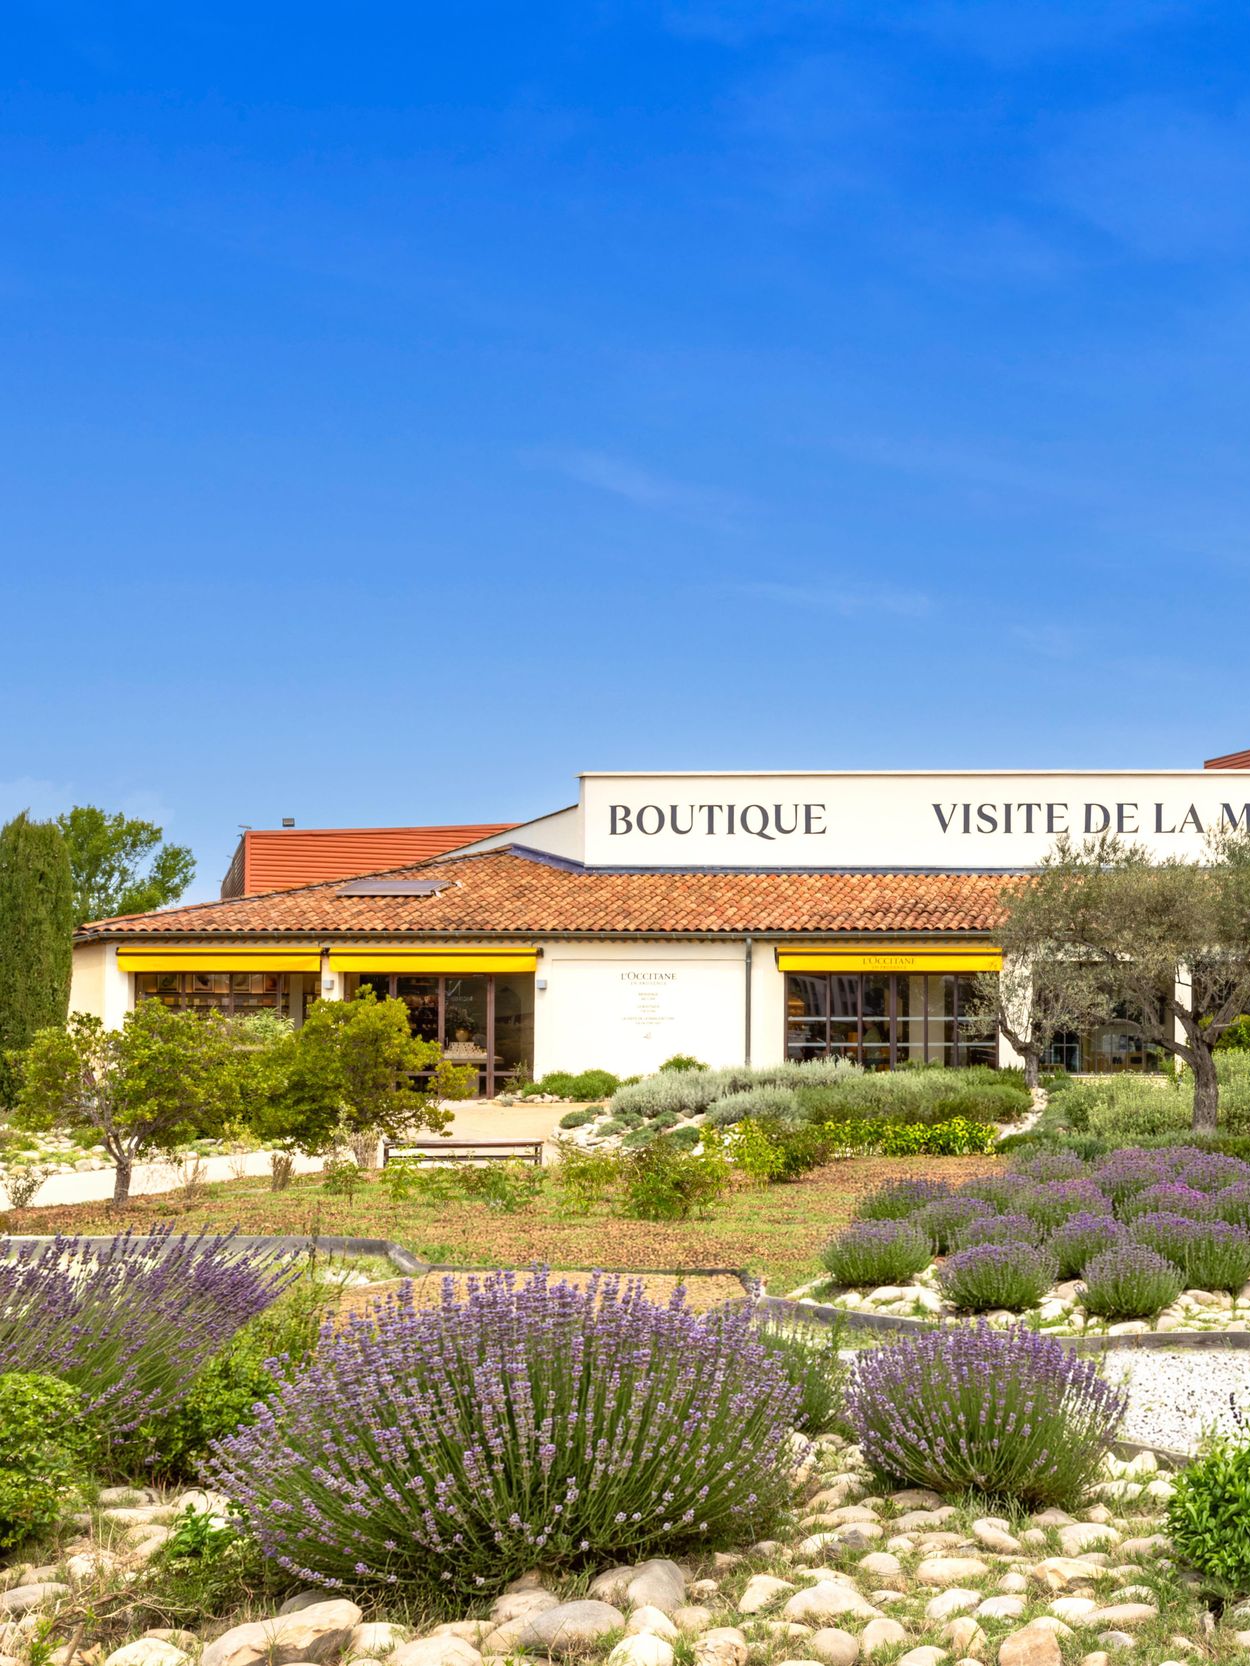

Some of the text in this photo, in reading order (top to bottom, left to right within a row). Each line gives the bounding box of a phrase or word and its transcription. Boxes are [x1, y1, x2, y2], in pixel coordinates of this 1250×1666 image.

[608, 803, 827, 841] BOUTIQUE
[931, 802, 1070, 835] VISITE
[1083, 802, 1140, 835] DE
[1154, 802, 1206, 835] LA
